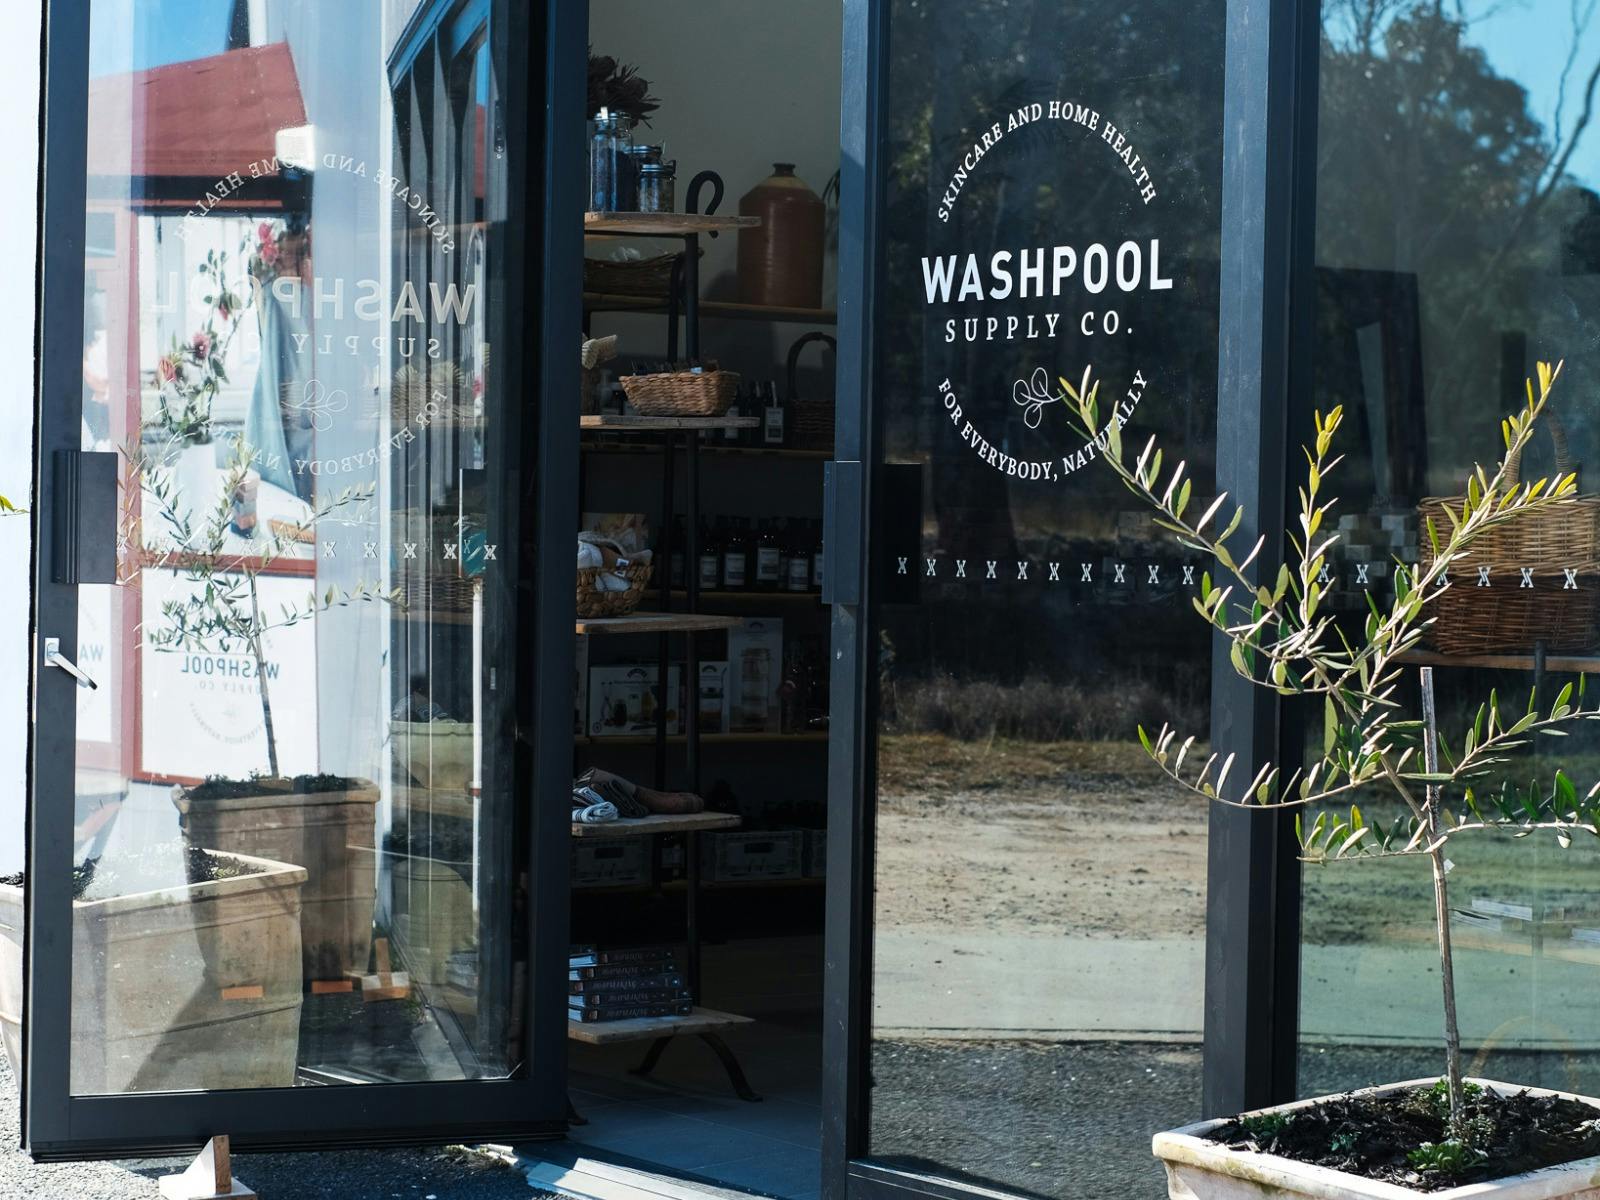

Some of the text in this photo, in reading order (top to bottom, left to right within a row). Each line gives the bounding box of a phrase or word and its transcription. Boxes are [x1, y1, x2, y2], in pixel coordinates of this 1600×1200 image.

[938, 101, 1157, 223] SKINCARE AND HOME HEALTH
[921, 239, 1173, 304] WASHPOOL
[945, 310, 1133, 342] SUPPLY CO.
[938, 378, 959, 426] FOR
[960, 421, 1058, 482] EVERYBODY,
